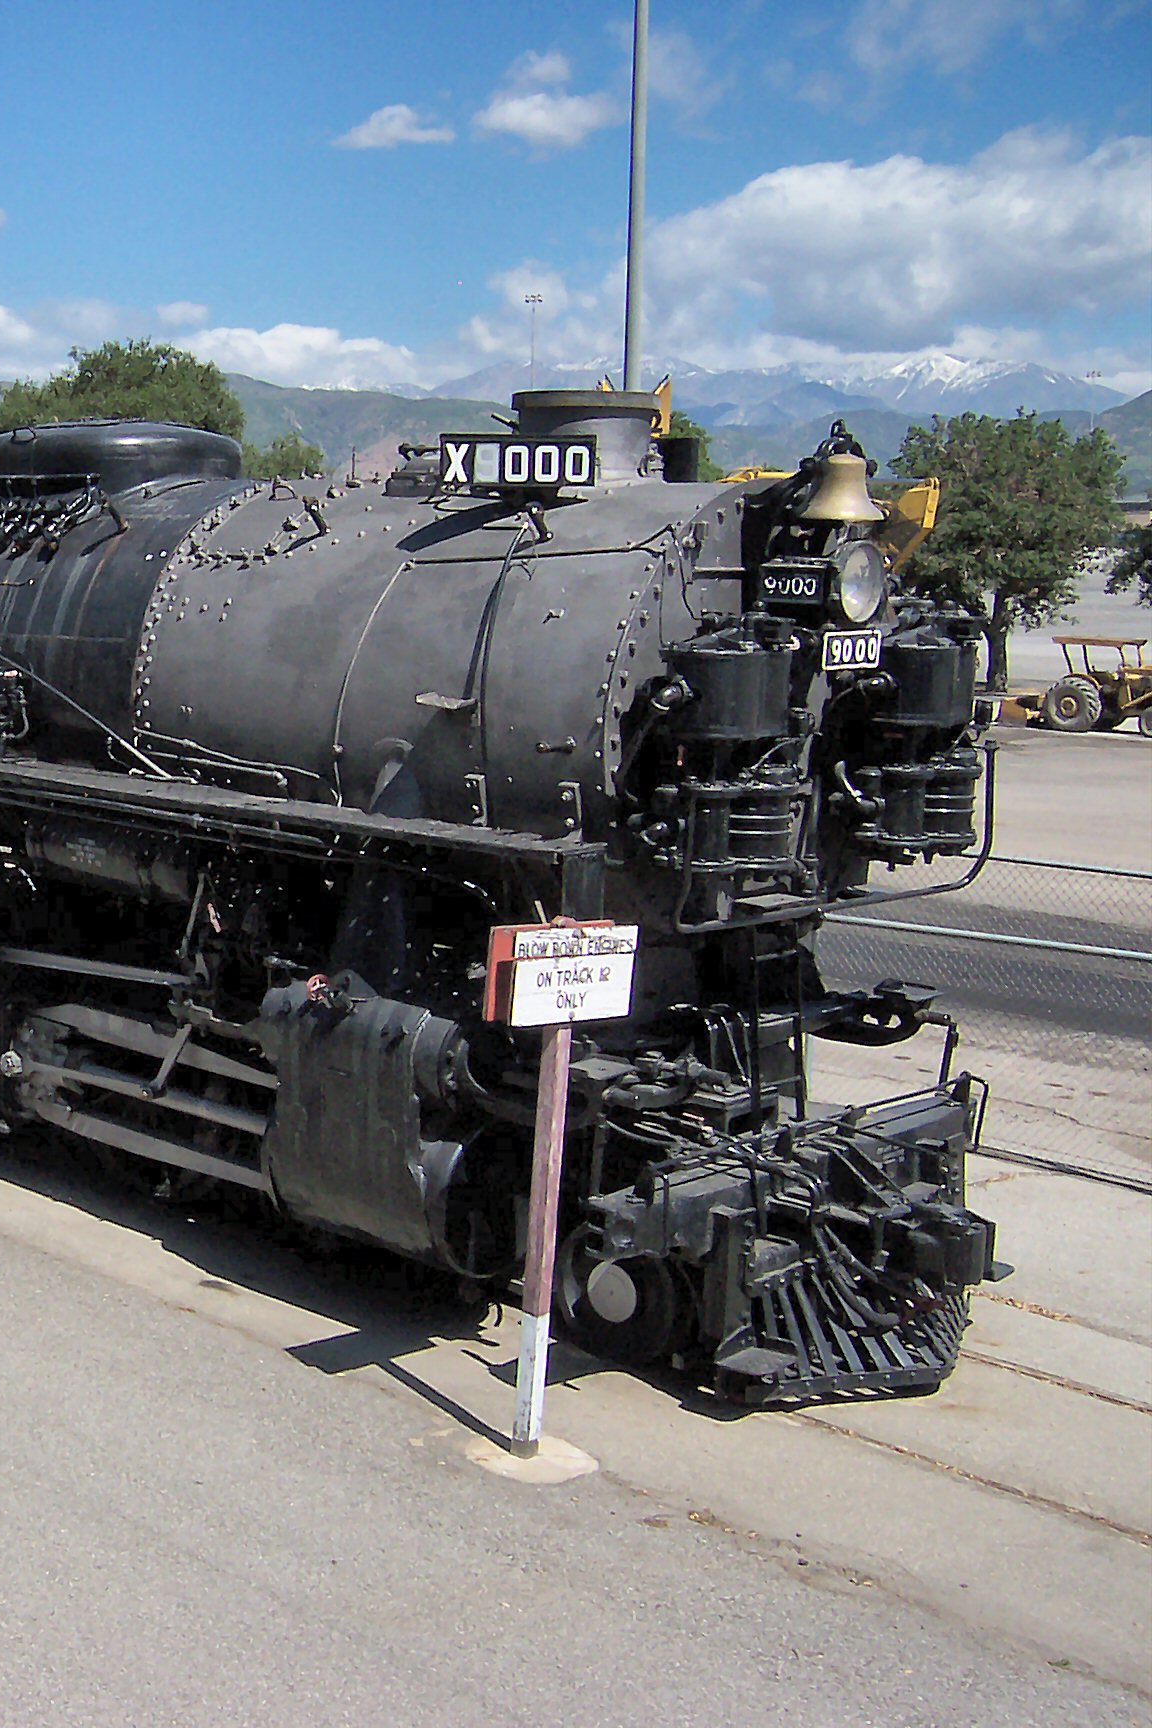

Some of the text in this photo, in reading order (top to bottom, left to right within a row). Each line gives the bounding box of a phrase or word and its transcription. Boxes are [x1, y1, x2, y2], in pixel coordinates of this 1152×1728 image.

[764, 576, 817, 596] 9000
[831, 637, 877, 664] 9000
[536, 973, 553, 988] ON
[556, 967, 594, 987] TRACK
[555, 991, 587, 1009] ONLY
